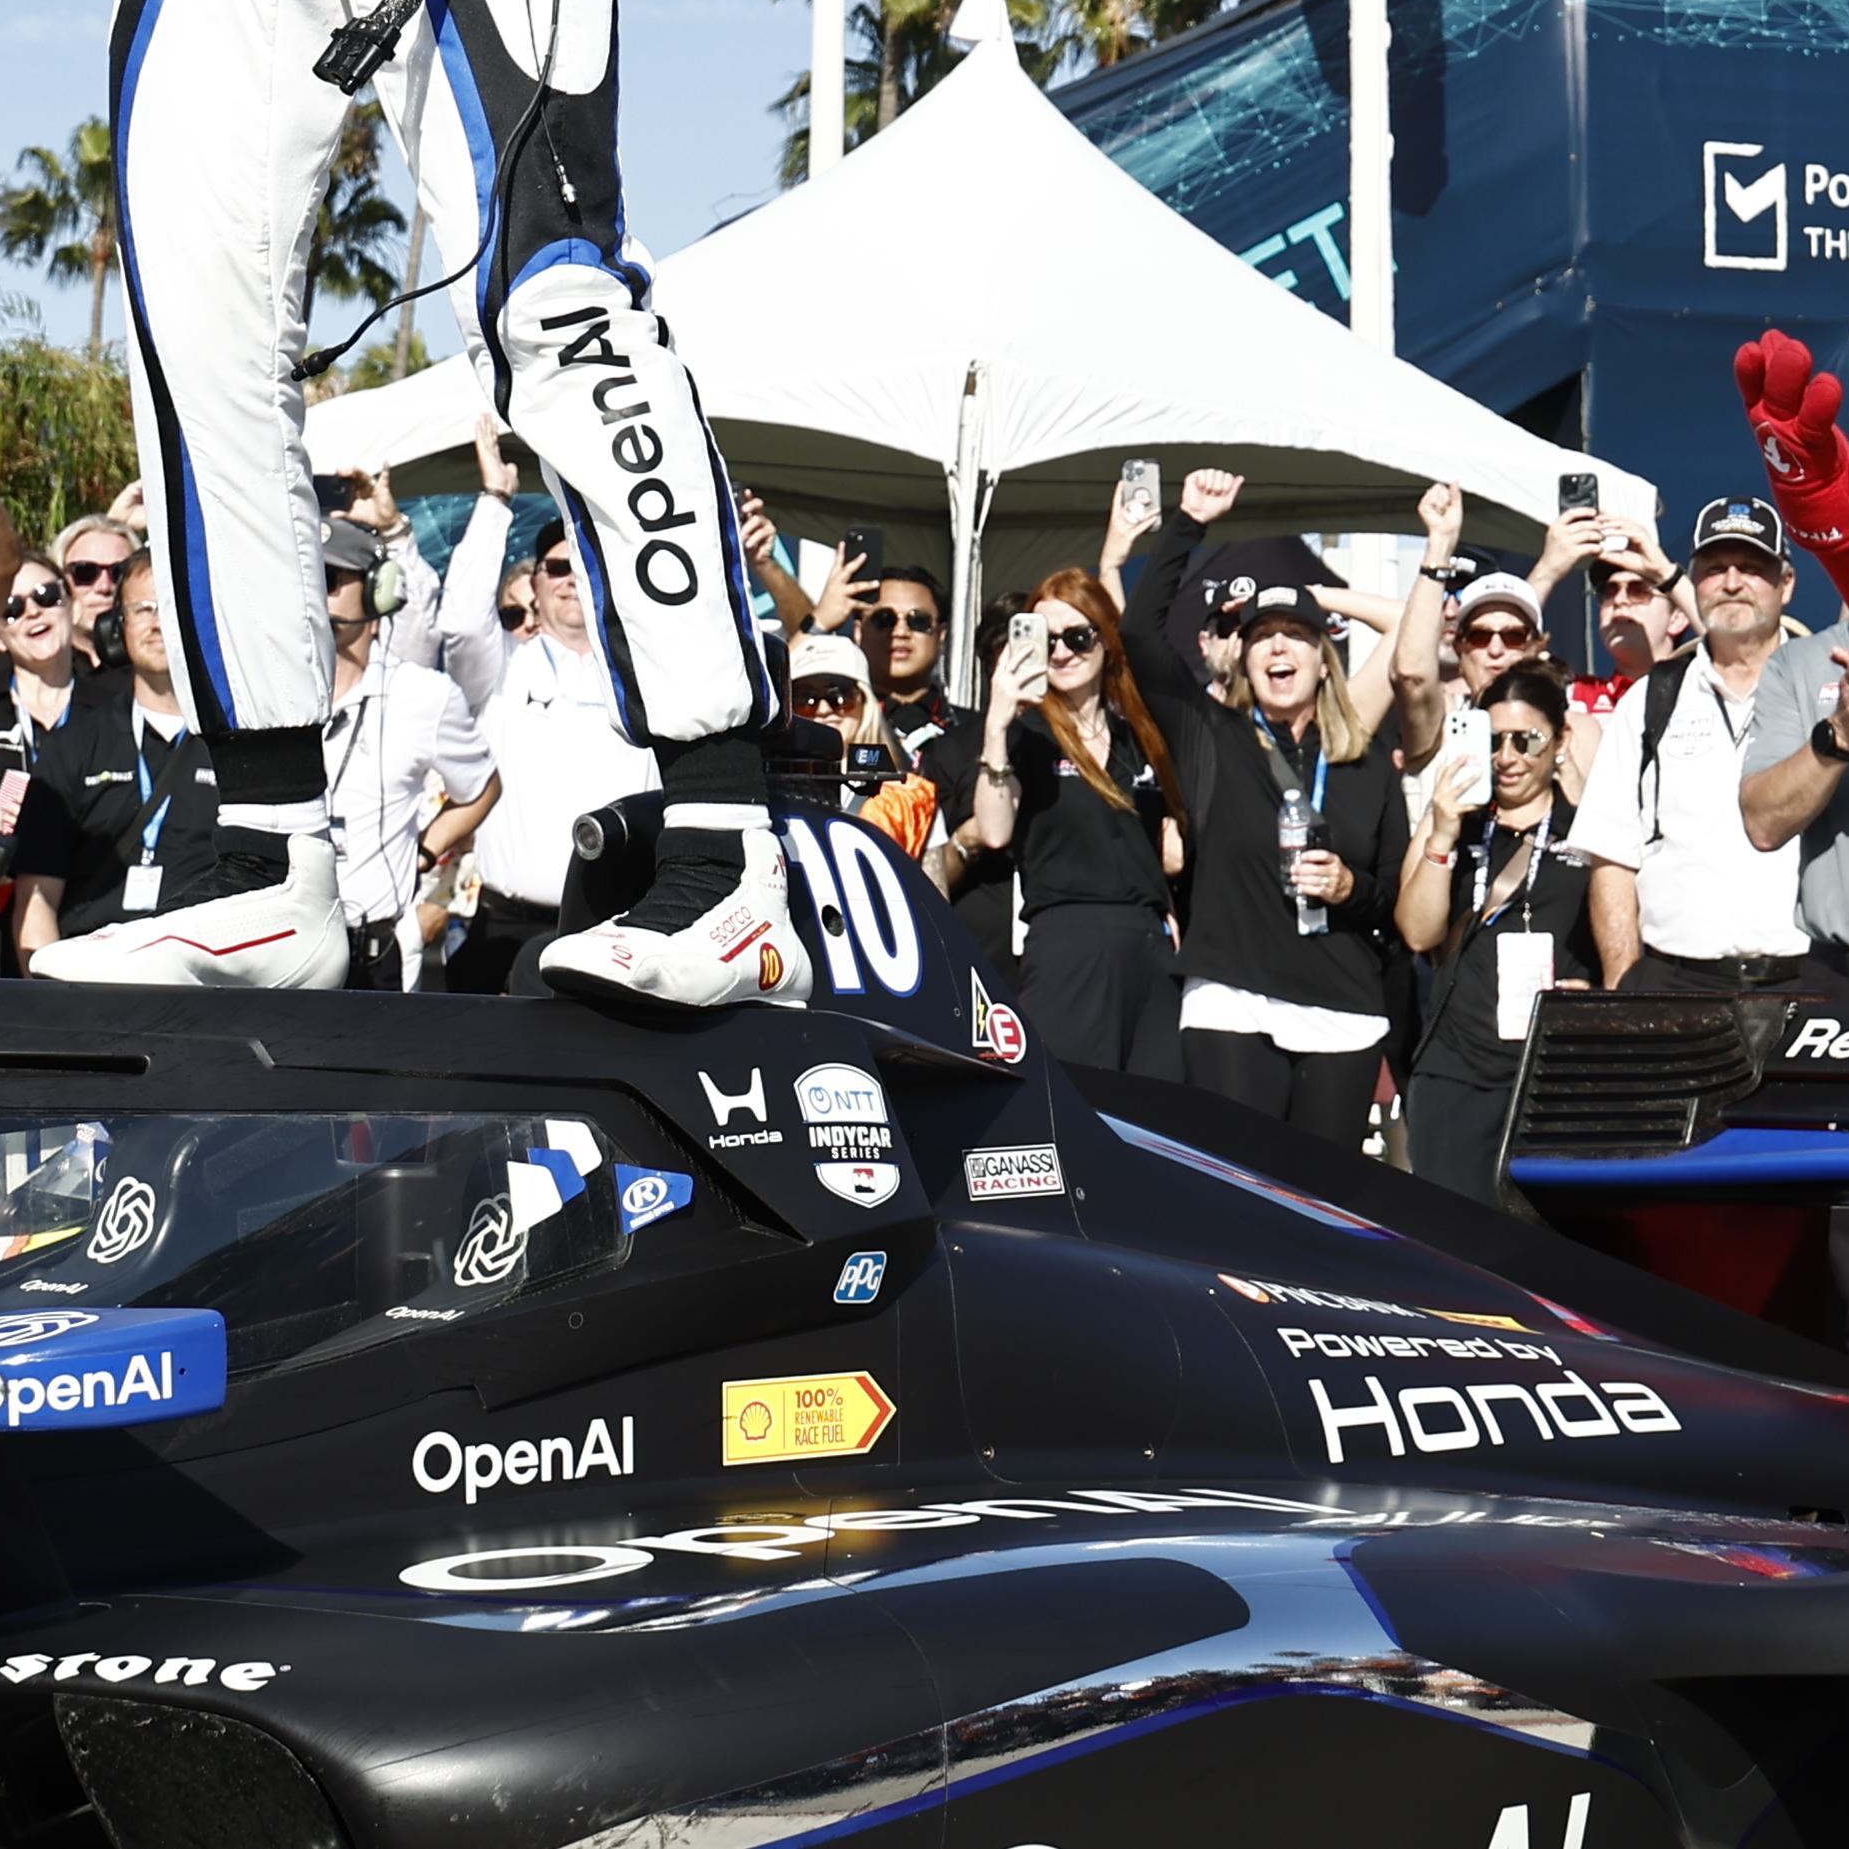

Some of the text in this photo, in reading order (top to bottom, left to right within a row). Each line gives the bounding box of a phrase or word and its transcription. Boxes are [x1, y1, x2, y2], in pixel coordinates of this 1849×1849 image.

[539, 305, 698, 607] OpenAI
[779, 813, 923, 996] 10
[709, 905, 752, 944] sparco
[762, 947, 781, 984] 10
[834, 1089, 875, 1113] NTT
[708, 1129, 783, 1150] Honda
[808, 1125, 893, 1150] INDYCAR
[831, 1146, 881, 1160] SERIES
[971, 1175, 1059, 1192] RACING
[20, 1278, 89, 1296] OpenAI
[839, 1256, 882, 1298] PPG
[385, 1304, 465, 1322] OpenAI
[1276, 1327, 1563, 1366] Powered by
[794, 1387, 844, 1410] 100%
[794, 1408, 845, 1427] RENEWABLE
[1308, 1370, 1683, 1464] Honda
[794, 1423, 846, 1447] RACE FUEL
[412, 1415, 635, 1505] OpenAI
[399, 1488, 1355, 1591] OpenAI
